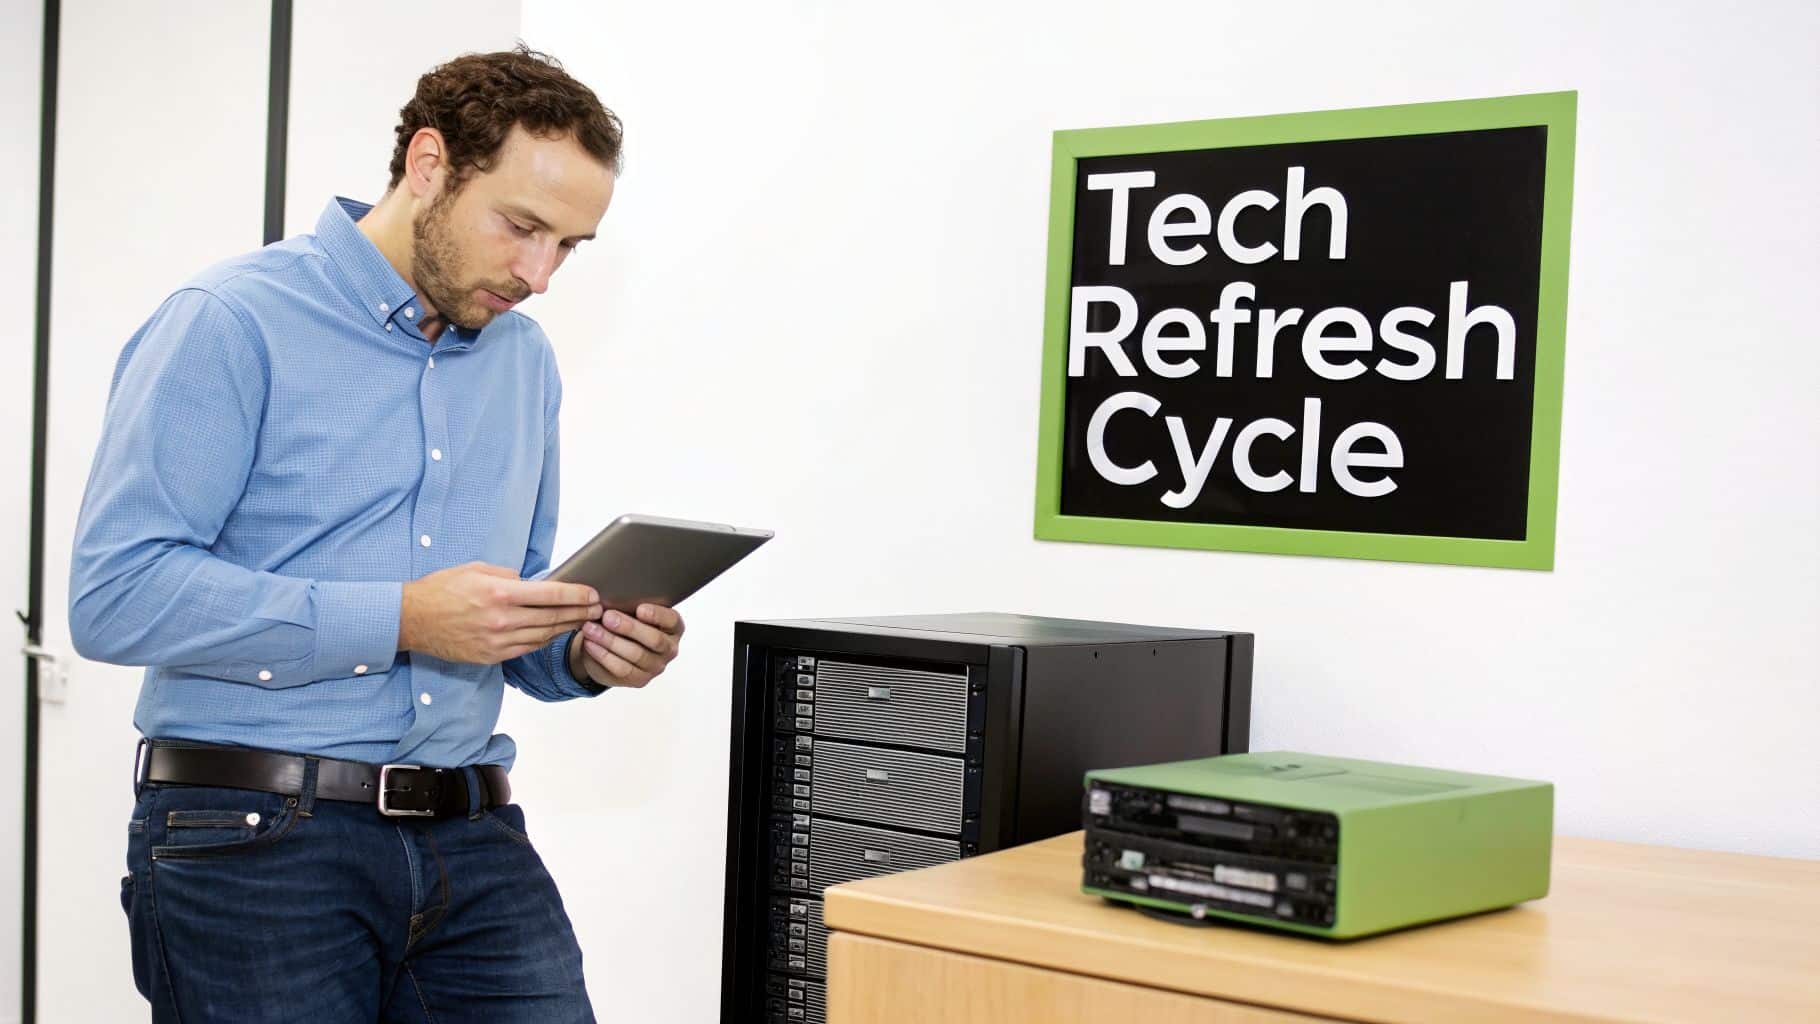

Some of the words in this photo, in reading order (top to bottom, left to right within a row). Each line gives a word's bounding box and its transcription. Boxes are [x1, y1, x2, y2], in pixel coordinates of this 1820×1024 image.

[1087, 166, 1348, 266] Tech
[1067, 281, 1516, 381] Refresh
[1086, 391, 1404, 509] Cycle
